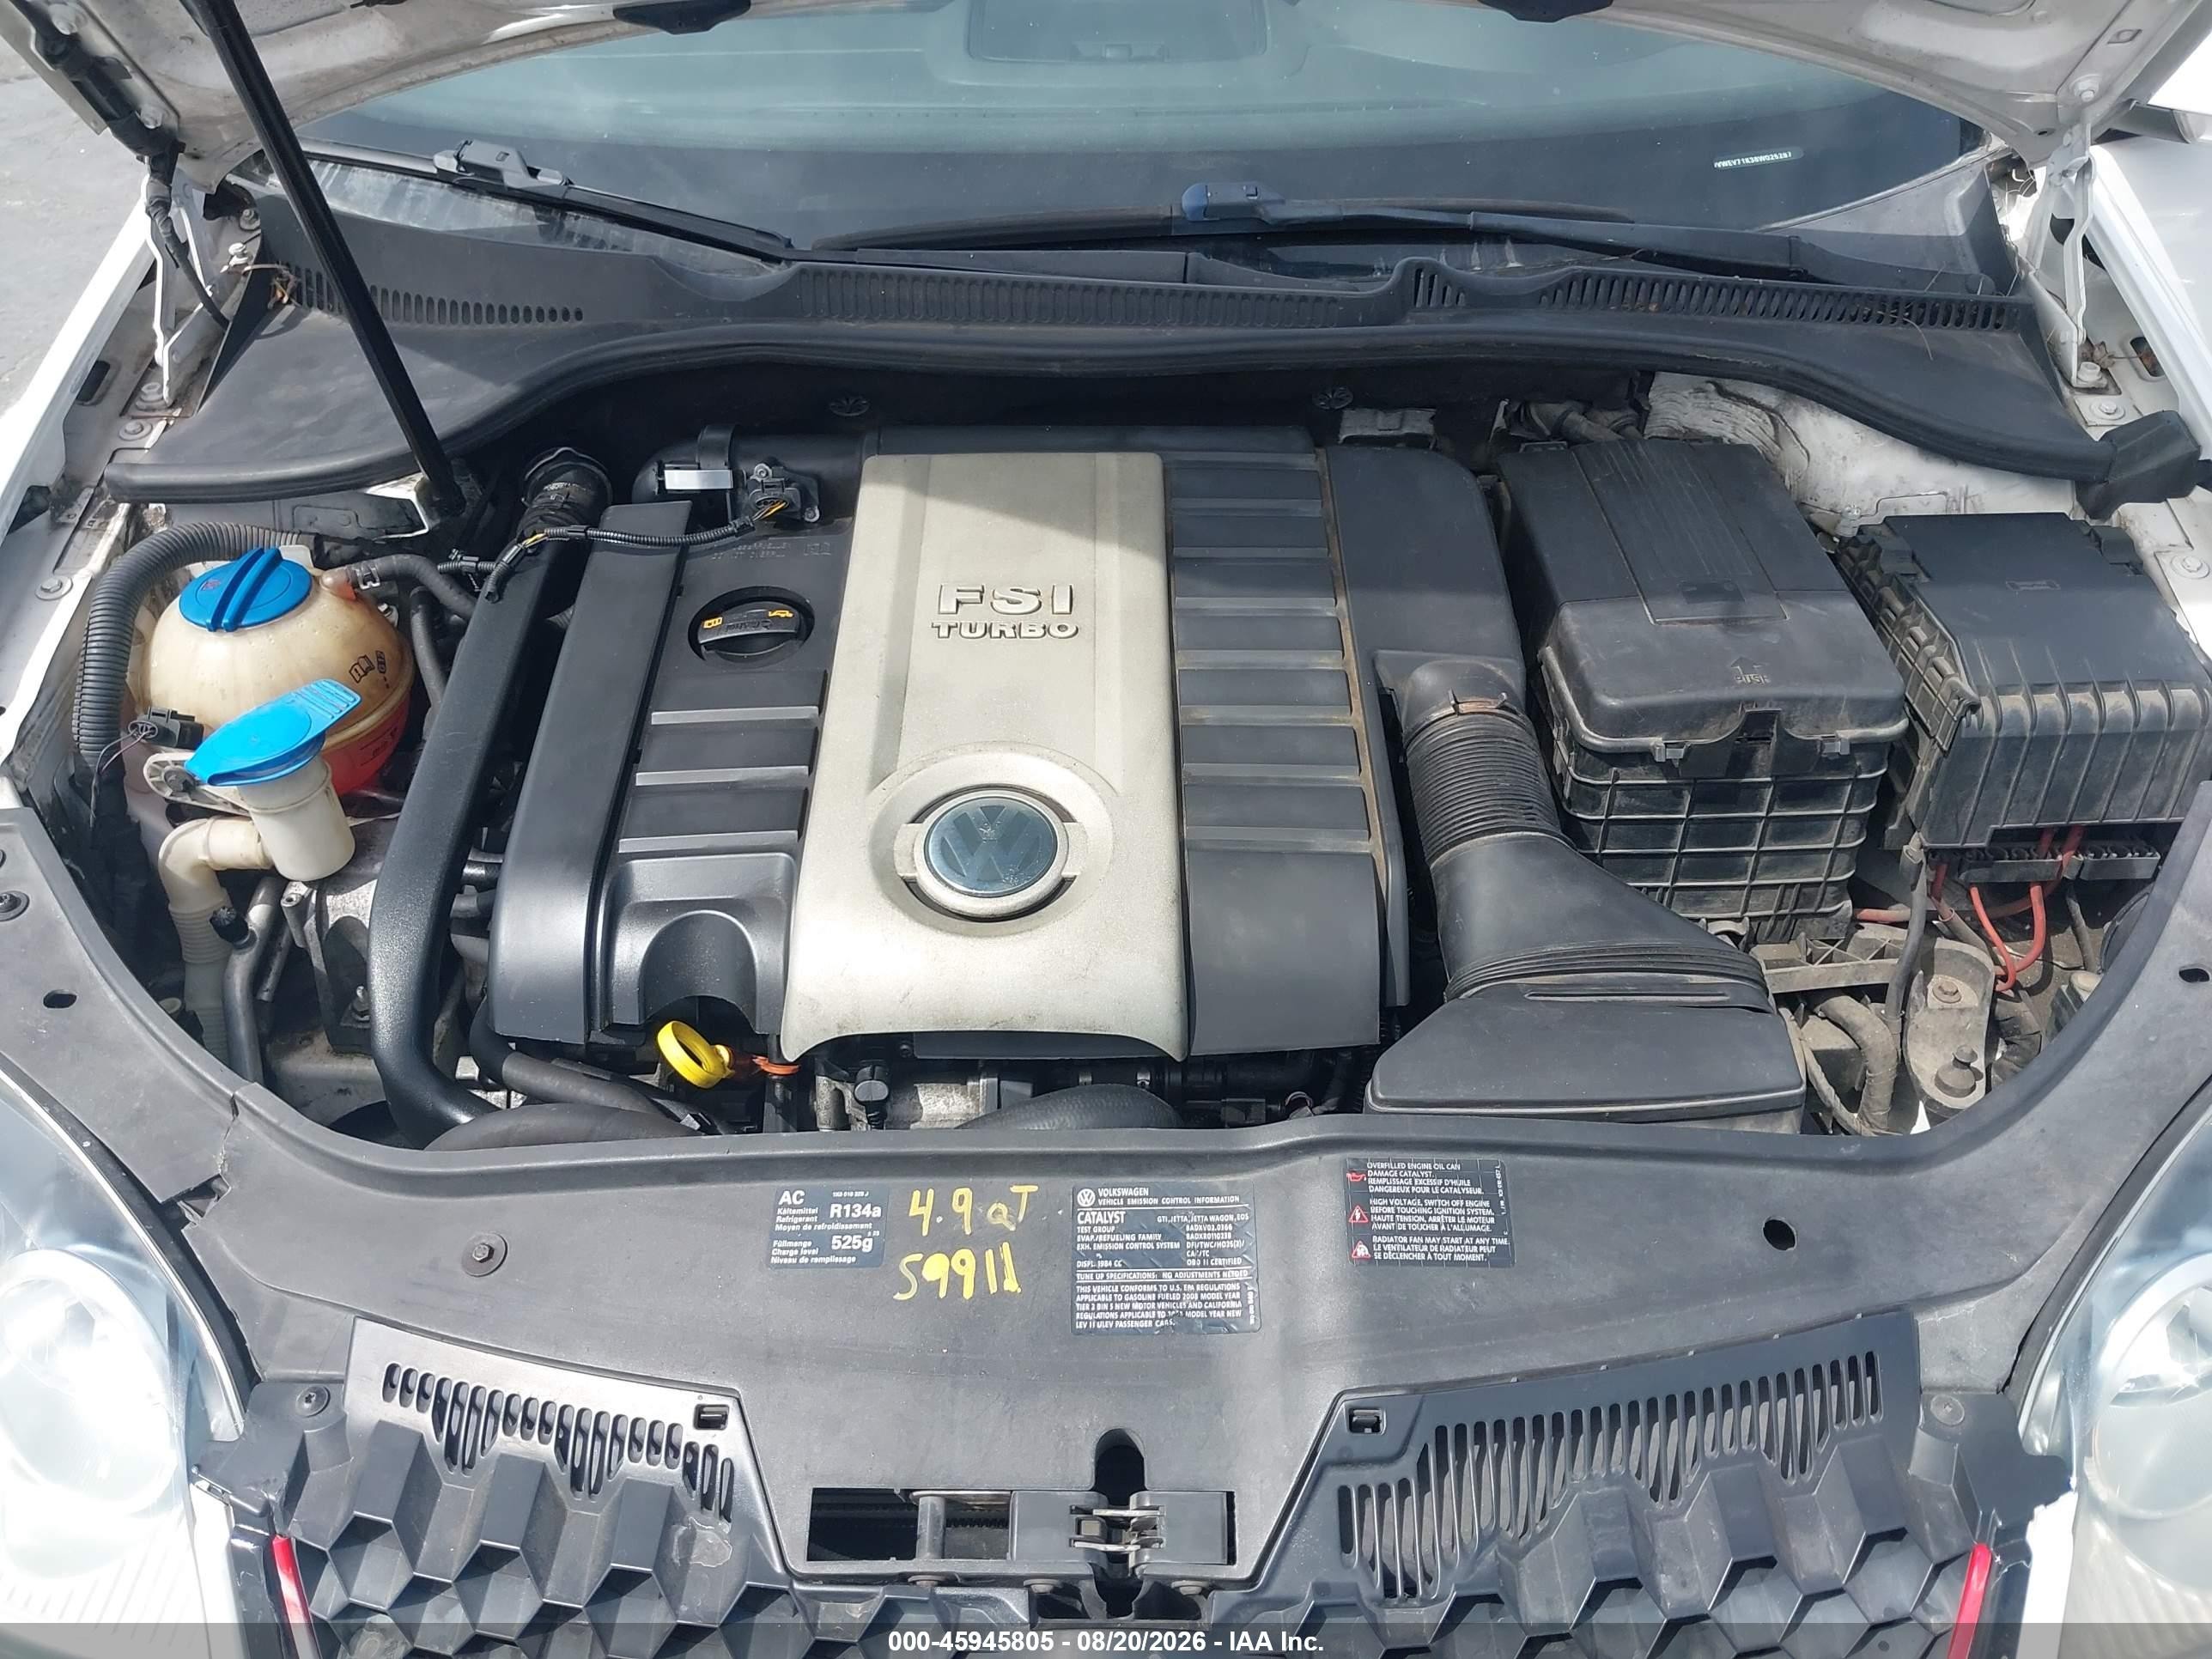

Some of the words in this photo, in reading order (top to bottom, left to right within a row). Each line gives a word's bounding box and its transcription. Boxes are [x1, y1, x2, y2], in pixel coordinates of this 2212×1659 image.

[938, 584, 1073, 615] FSI
[931, 621, 1079, 639] TURBO
[778, 1189, 805, 1205] AC
[1097, 1188, 1149, 1197] VOLKSWAGEN
[1162, 1196, 1191, 1205] CONTROL
[1194, 1195, 1240, 1204] INFORMATION
[830, 1203, 882, 1218] R134a
[908, 1187, 974, 1237] 4.9
[1466, 1207, 1495, 1216] SYSTEM.
[1077, 1211, 1126, 1224] CATALYST
[1426, 1213, 1456, 1223] ARRÊTER
[1466, 1216, 1495, 1224] MOTEUR
[775, 1224, 801, 1232] Moyen
[813, 1222, 872, 1231] refroidissement
[1407, 1223, 1438, 1231] TOUCHER
[831, 1235, 873, 1252] 525g
[1093, 1242, 1125, 1250] EMISSION
[1127, 1242, 1155, 1250] CONTROL
[810, 1255, 856, 1264] remplissage
[1453, 1253, 1487, 1261] MOMENT.
[1120, 1284, 1158, 1292] CONFORMS
[1196, 1283, 1241, 1291] REGULATIONS
[1113, 1293, 1123, 1302] TO
[1158, 1292, 1181, 1301] FUELED
[1224, 1291, 1240, 1300] YEAR
[1076, 1311, 1119, 1320] REGULATIONS
[1208, 1310, 1225, 1318] YEAR
[1076, 1321, 1088, 1329] LEV
[1097, 1320, 1114, 1328] ULEV
[1115, 1319, 1153, 1328] PASSENGER
